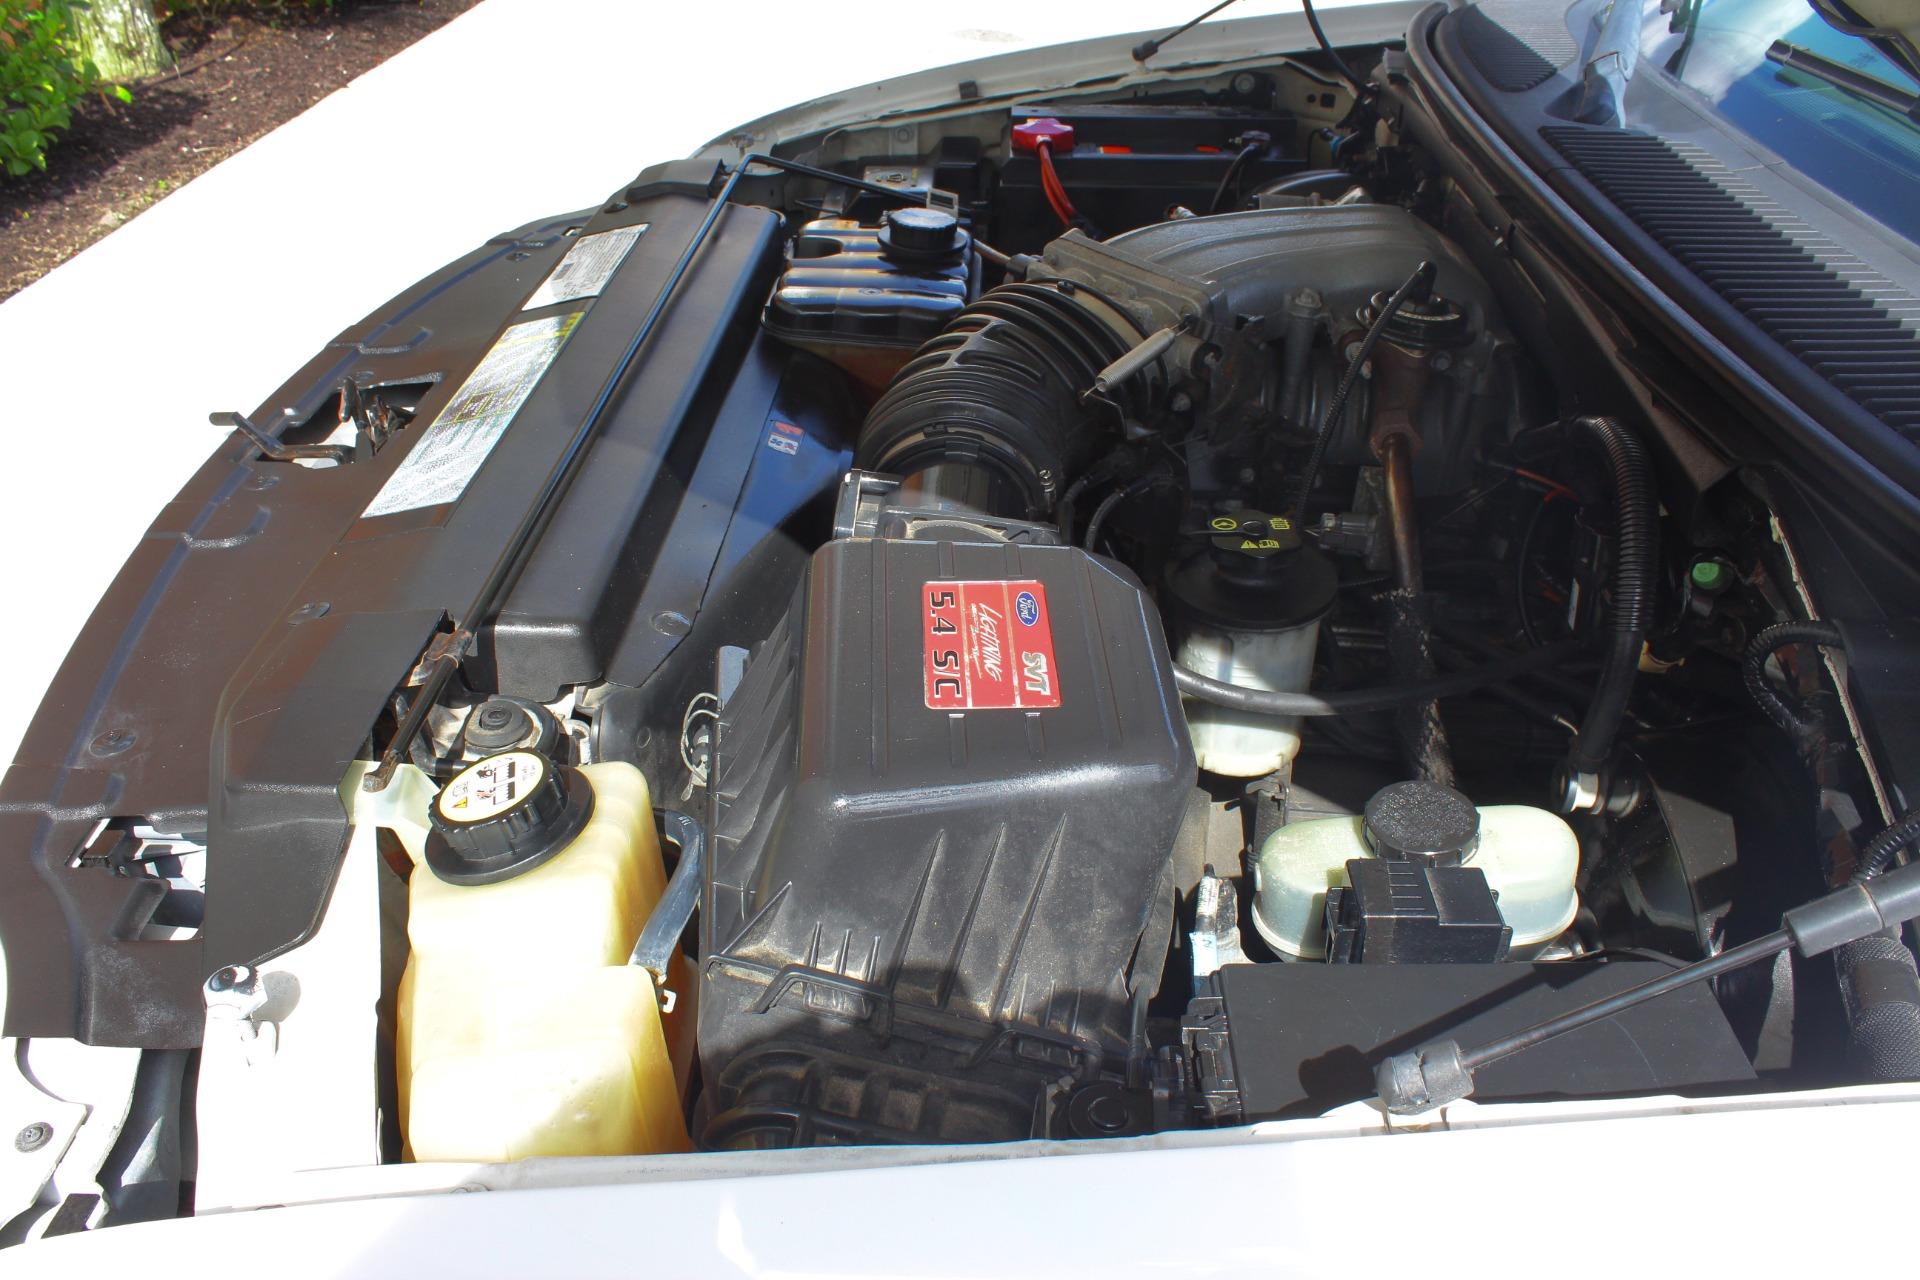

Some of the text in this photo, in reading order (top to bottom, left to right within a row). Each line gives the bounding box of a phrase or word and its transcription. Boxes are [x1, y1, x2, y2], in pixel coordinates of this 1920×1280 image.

[1018, 596, 1036, 624] Ford
[930, 591, 963, 699] 5.4 S/C
[978, 602, 1003, 682] LIGHTNING
[1021, 651, 1051, 695] SVT
